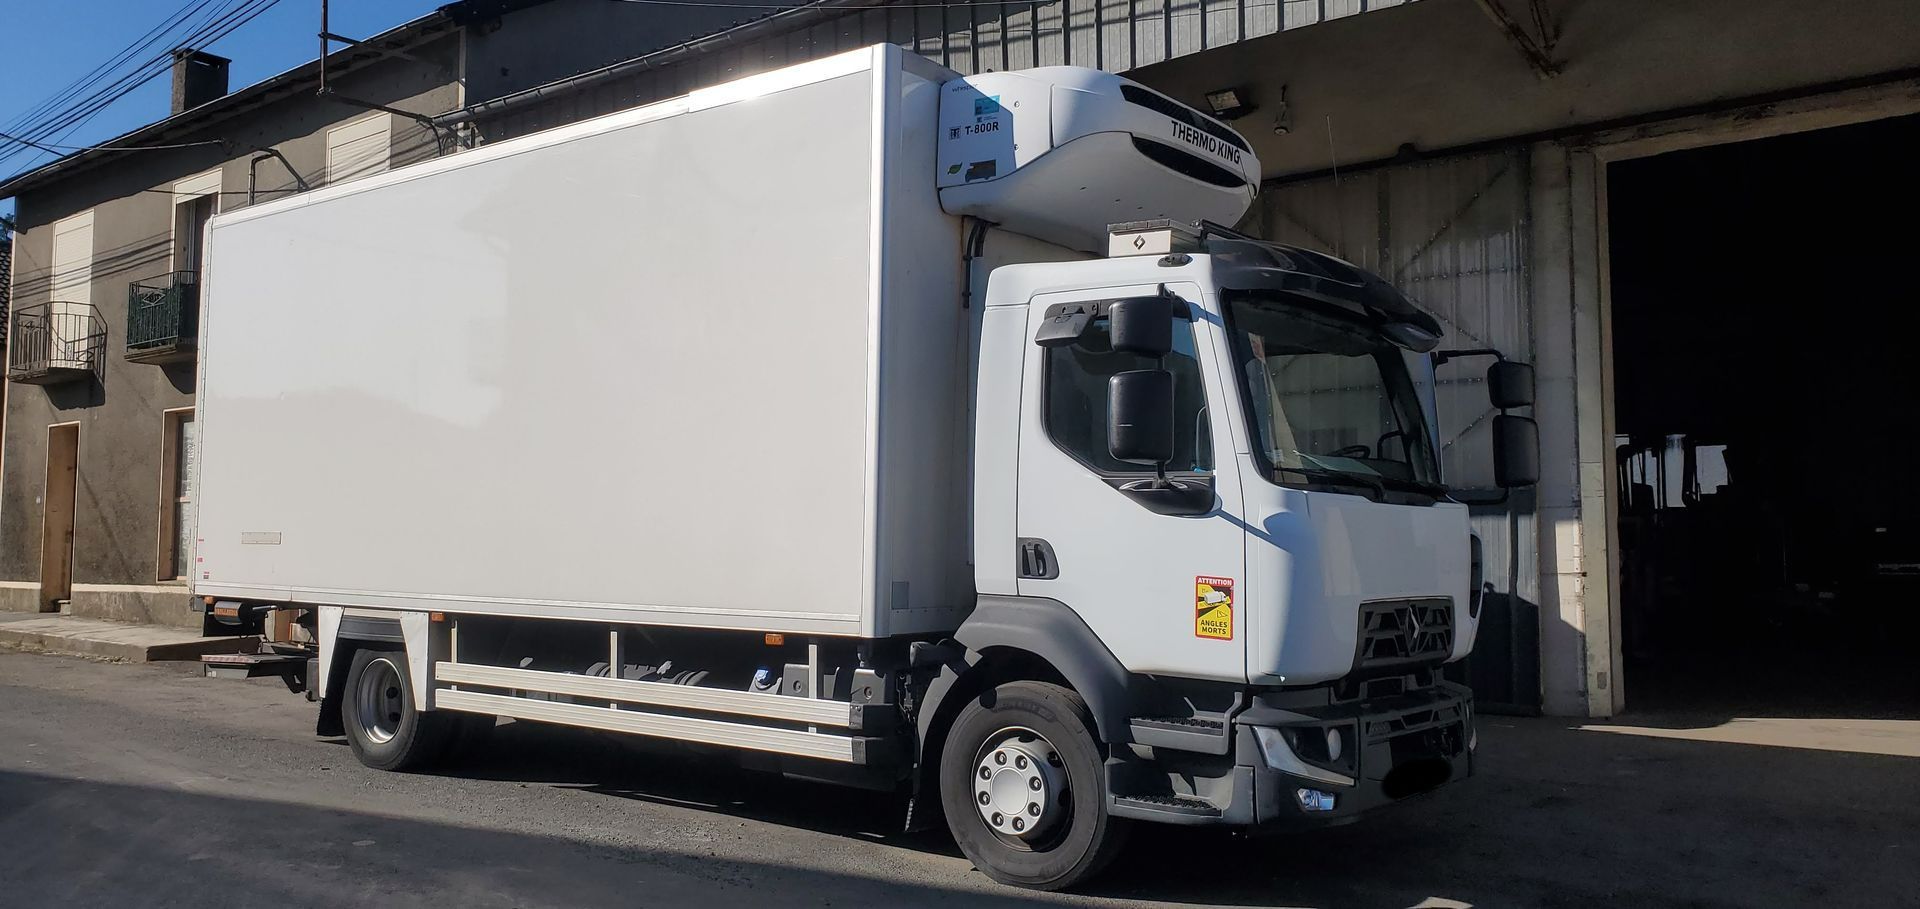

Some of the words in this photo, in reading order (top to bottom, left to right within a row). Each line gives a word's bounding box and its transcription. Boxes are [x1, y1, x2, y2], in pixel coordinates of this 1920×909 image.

[965, 122, 999, 135] T-800R
[1171, 120, 1216, 152] THERMO
[1217, 141, 1240, 164] KING
[1198, 578, 1232, 586] ATTENTION
[1200, 620, 1228, 628] ANGLES
[1201, 627, 1227, 635] MORTS
